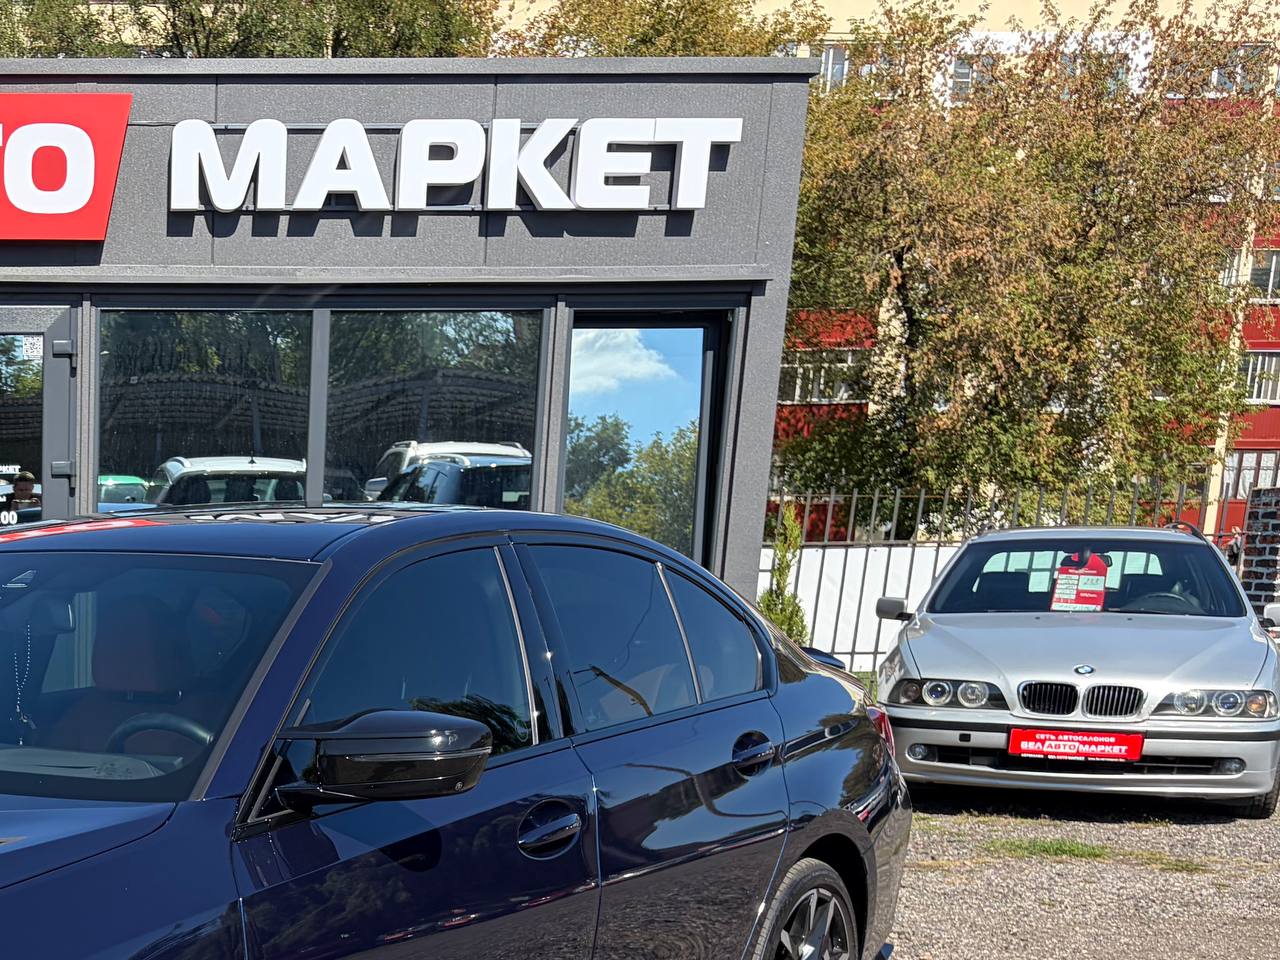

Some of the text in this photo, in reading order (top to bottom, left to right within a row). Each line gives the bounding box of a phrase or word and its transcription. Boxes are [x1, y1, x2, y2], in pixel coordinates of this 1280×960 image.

[170, 117, 744, 213] МАРКЕТ
[1058, 734, 1116, 743] АВТОСАЛОНОВ
[1020, 741, 1128, 754] БЕЛ АВТО МАРКЕТ
